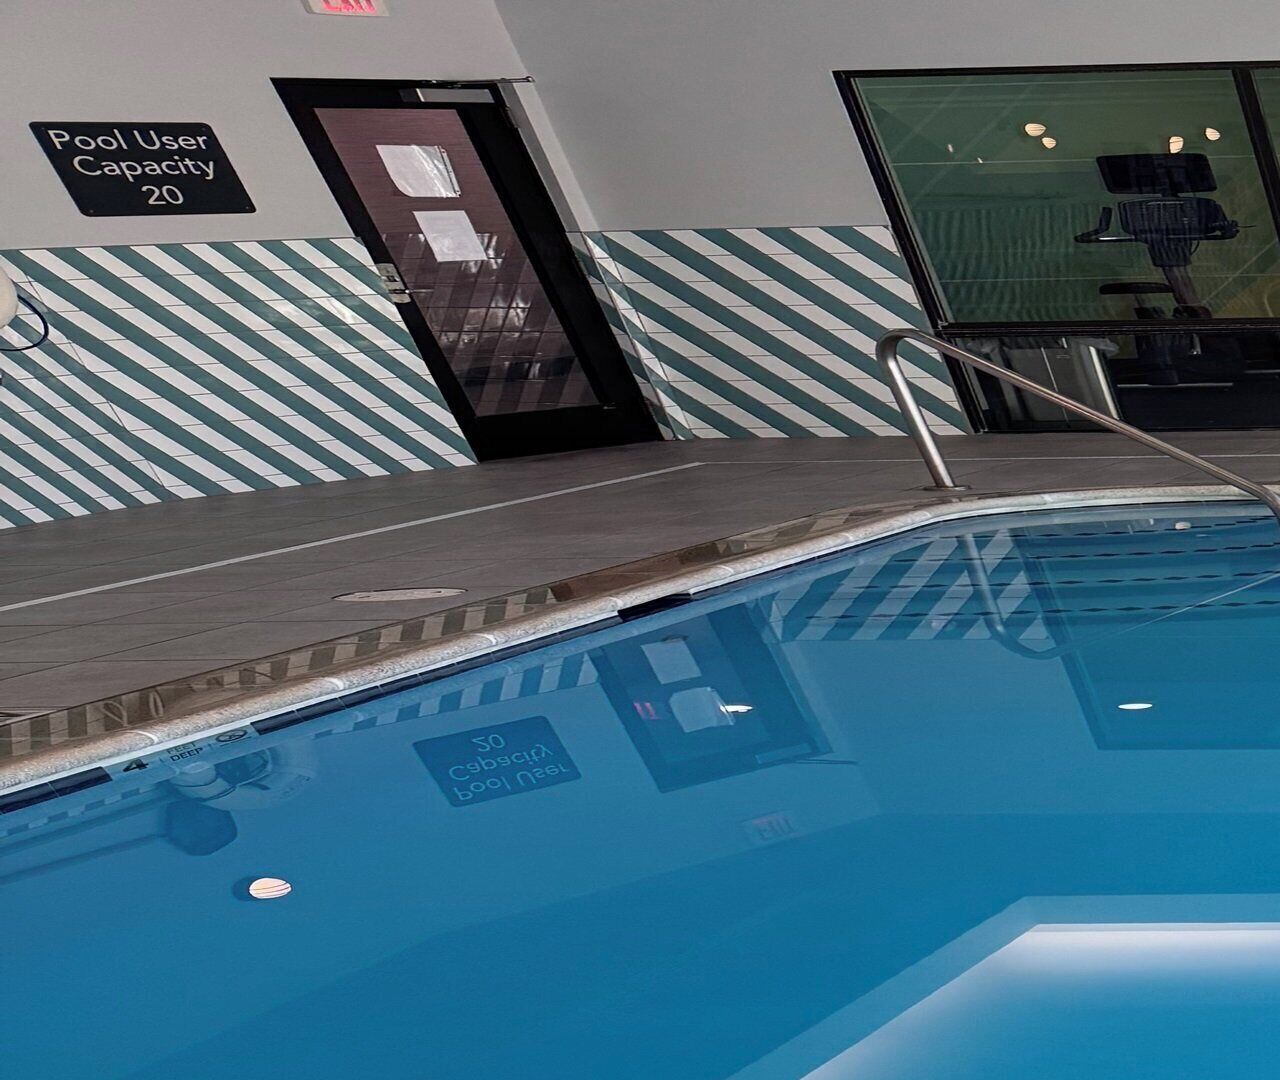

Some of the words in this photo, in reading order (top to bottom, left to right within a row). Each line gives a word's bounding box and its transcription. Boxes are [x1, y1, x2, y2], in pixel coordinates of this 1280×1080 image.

[47, 128, 128, 150] Pool
[133, 129, 208, 150] User
[72, 155, 214, 182] Capacity
[141, 185, 184, 205] 20
[169, 747, 204, 762] DEEP
[122, 758, 149, 773] 4
